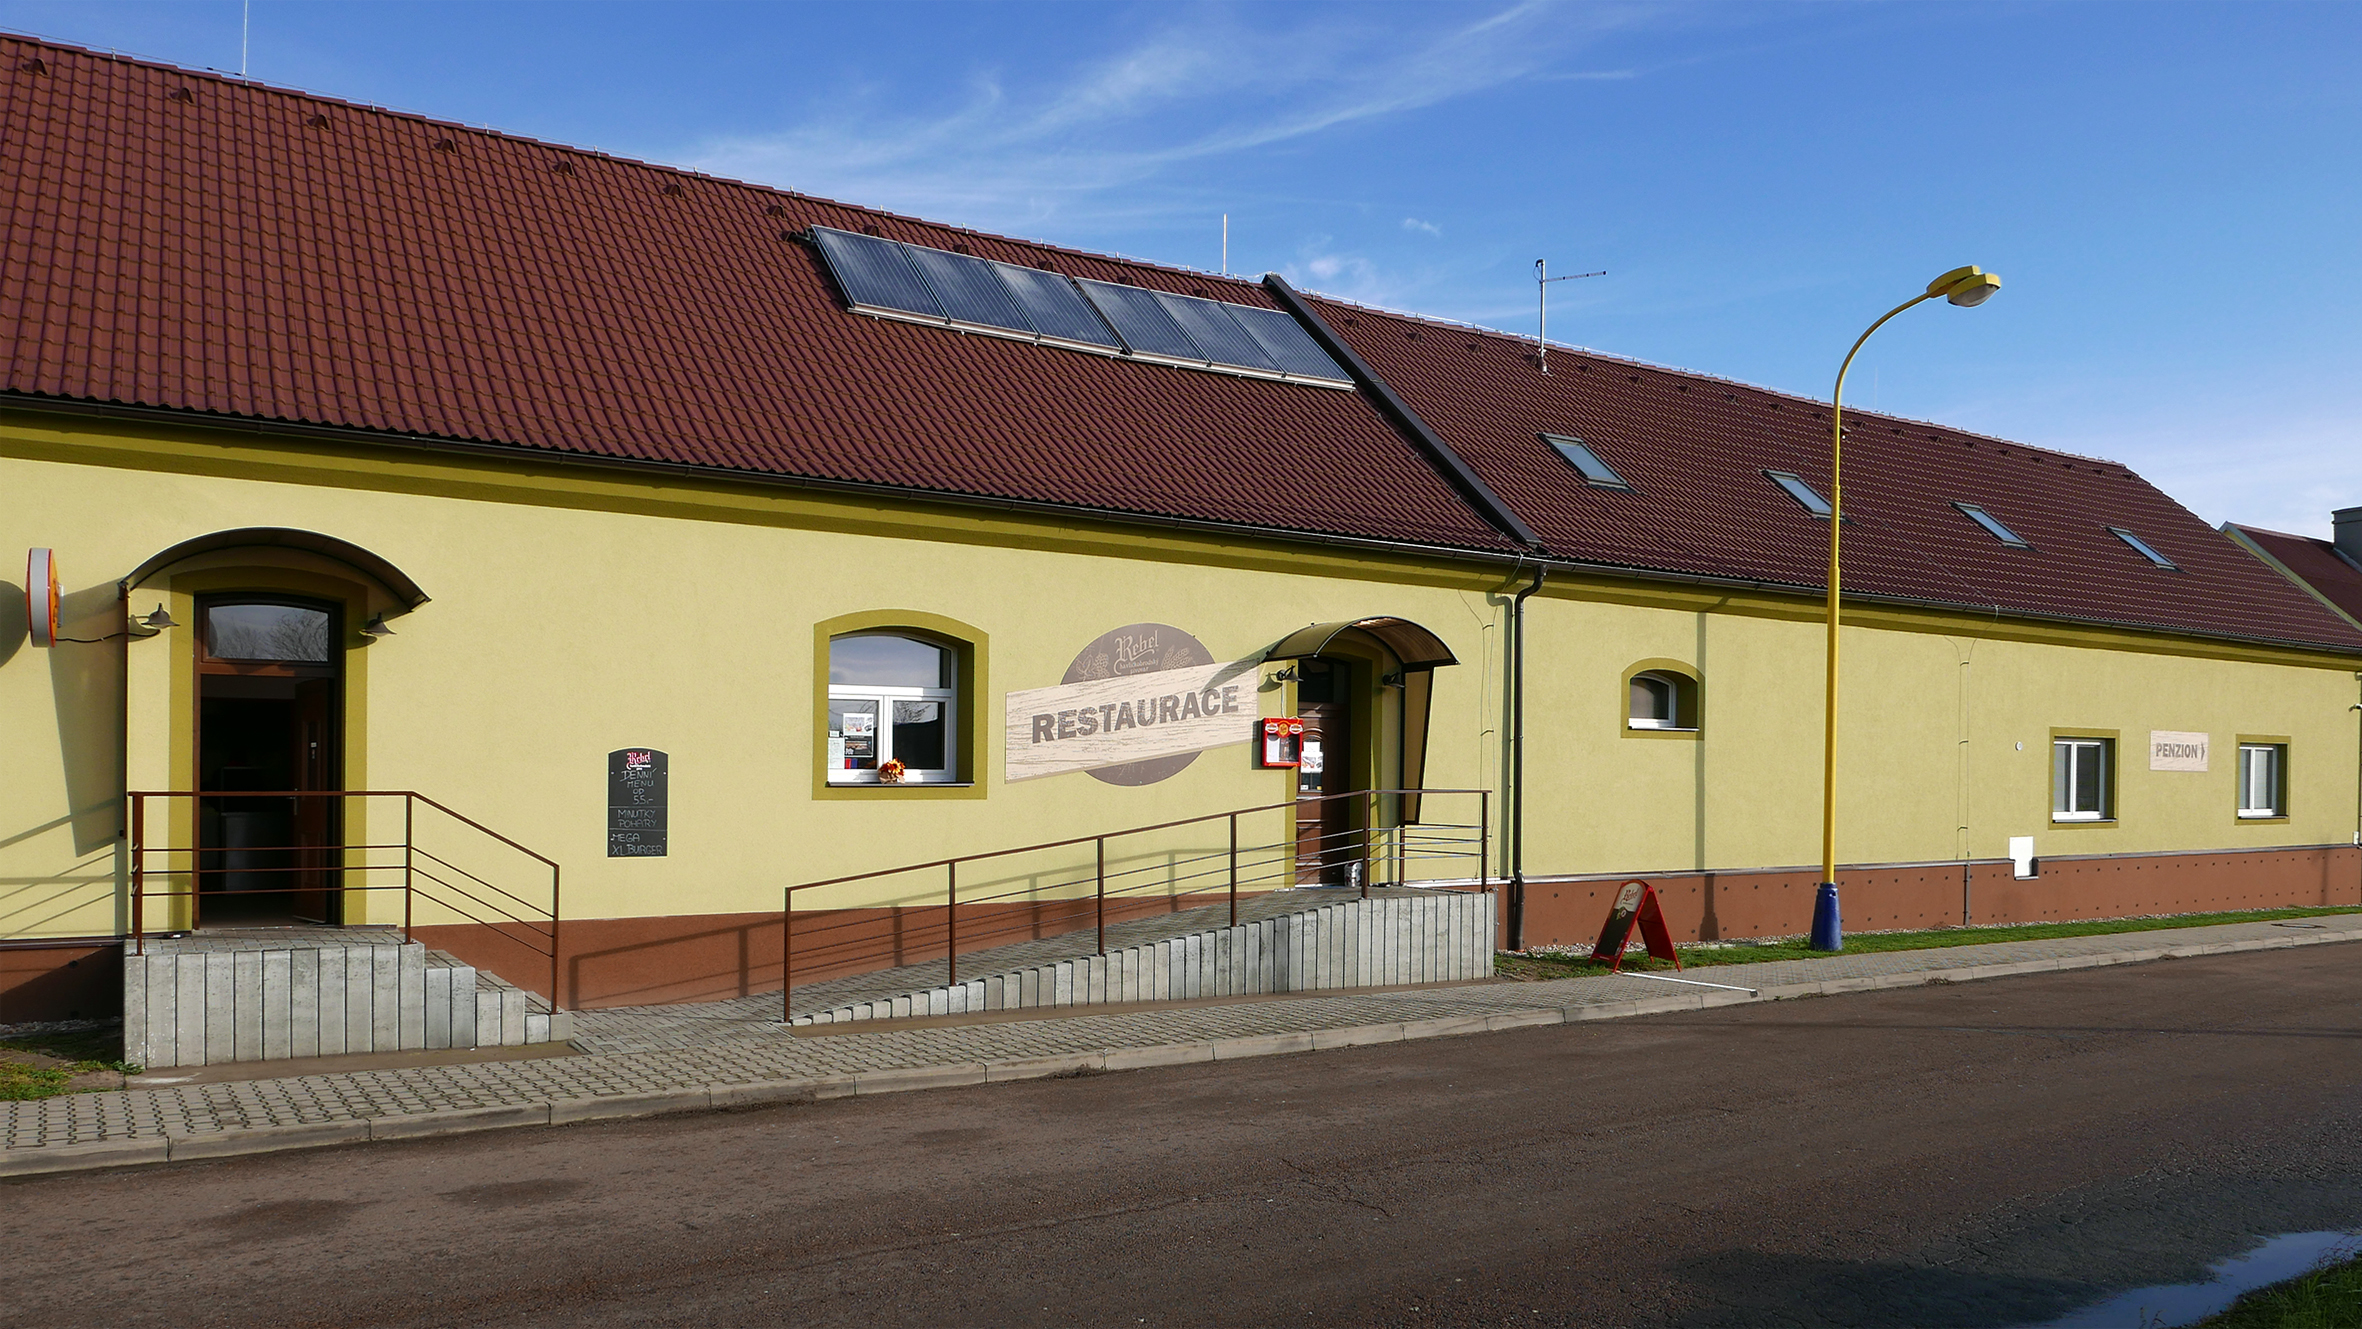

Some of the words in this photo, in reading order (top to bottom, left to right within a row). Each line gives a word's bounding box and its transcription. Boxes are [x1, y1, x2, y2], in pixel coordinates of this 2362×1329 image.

[1114, 629, 1159, 670] Rebel
[1032, 685, 1239, 744] RESTAURACE
[2155, 743, 2198, 758] PENZION
[627, 780, 654, 788] MENU
[612, 833, 640, 843] MEGA
[626, 844, 663, 856] BURGER
